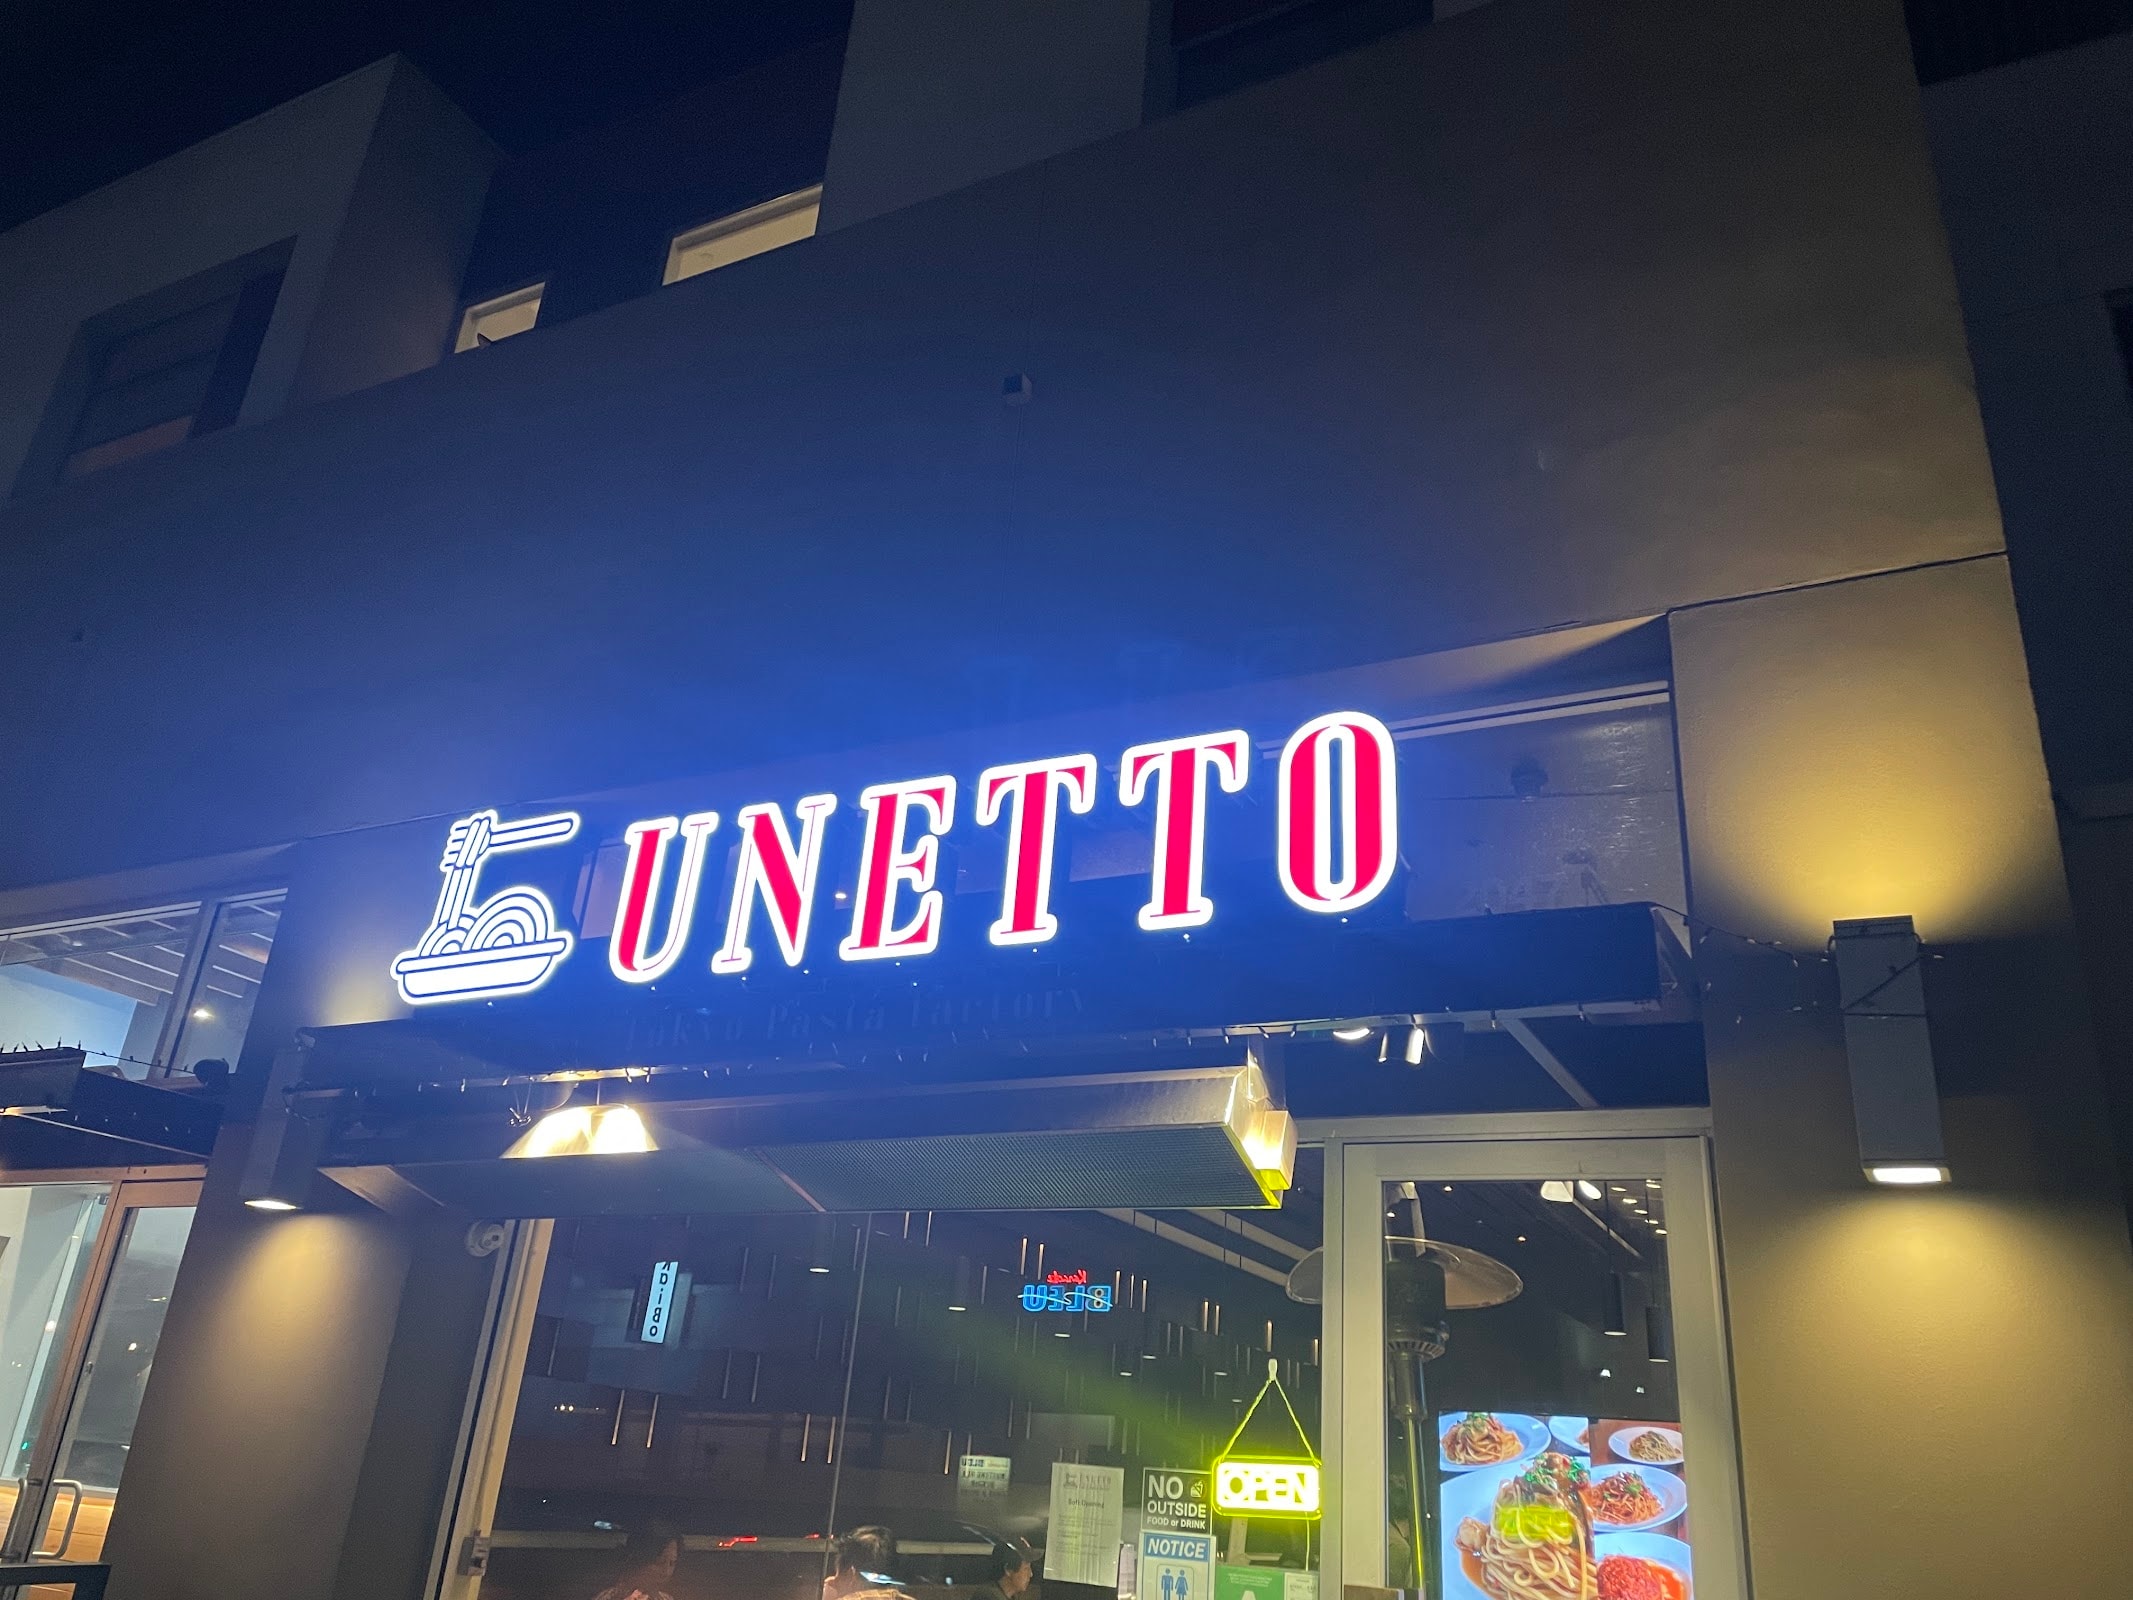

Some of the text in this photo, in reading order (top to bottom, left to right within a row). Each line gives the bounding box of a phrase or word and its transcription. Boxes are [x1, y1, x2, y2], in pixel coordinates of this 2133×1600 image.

[1148, 1474, 1184, 1500] NO
[1219, 1466, 1314, 1507] OPEN
[1147, 1501, 1207, 1519] OUTSIDE
[1146, 1516, 1206, 1530] FOOD or DRINK
[1148, 1538, 1206, 1559] NOTICE
